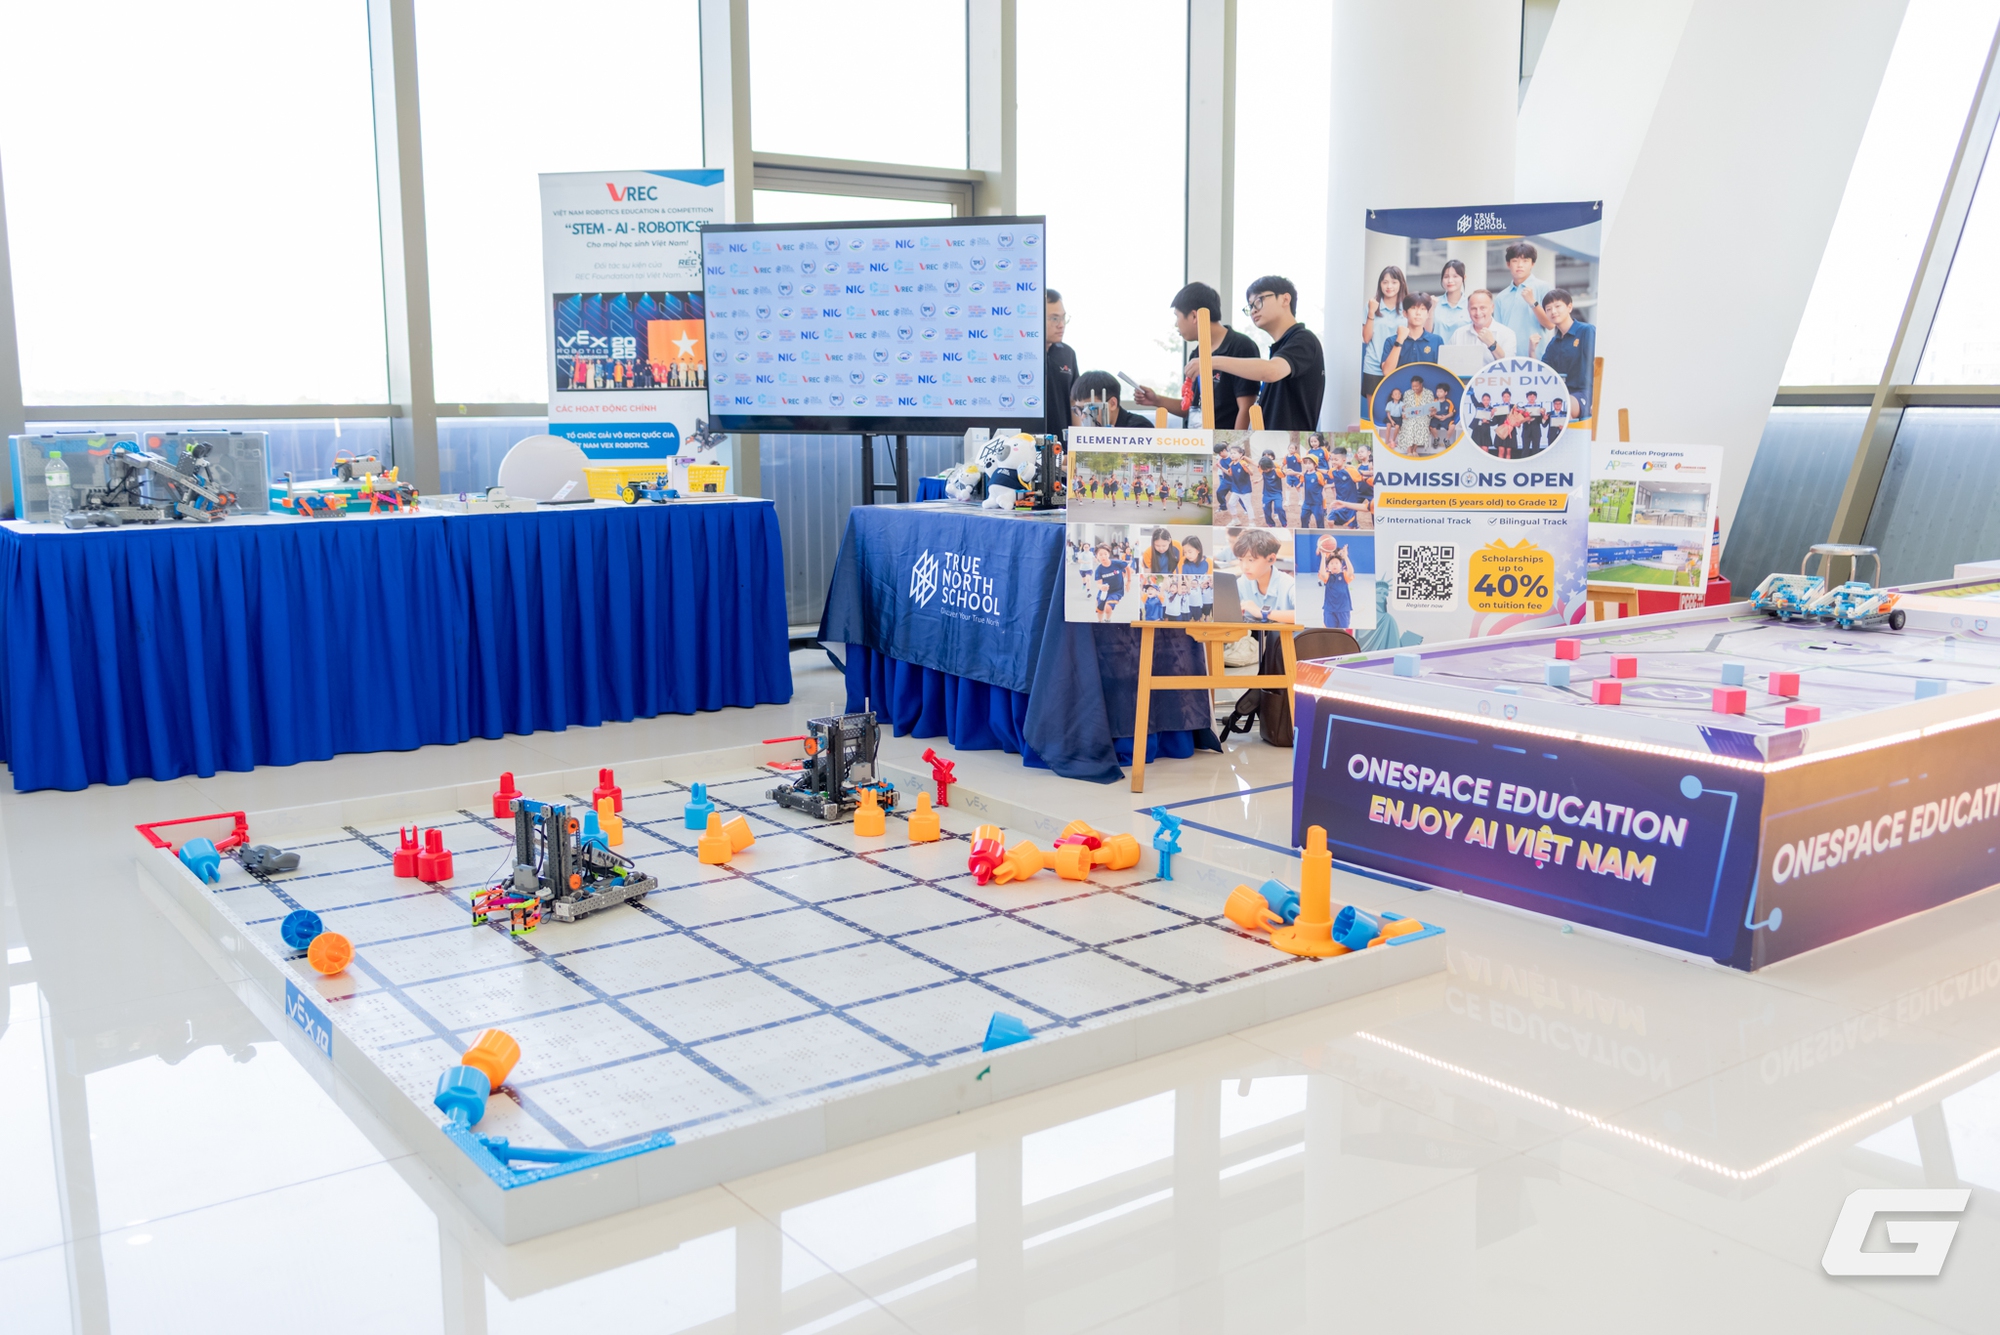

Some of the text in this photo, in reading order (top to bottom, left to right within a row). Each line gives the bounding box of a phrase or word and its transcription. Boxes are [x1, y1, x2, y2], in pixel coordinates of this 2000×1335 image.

[606, 183, 658, 202] VREC
[614, 222, 628, 234] AI
[603, 241, 617, 249] mọi
[619, 240, 632, 249] học
[652, 240, 666, 248] Việt
[729, 243, 748, 253] NIC
[896, 239, 914, 249] NIC
[707, 266, 725, 275] NIC
[870, 262, 889, 272] NIC
[592, 272, 634, 280] Foundation
[846, 285, 865, 294] NIC
[1016, 282, 1036, 291] NIC
[823, 309, 842, 318] NIC
[992, 306, 1011, 316] NIC
[557, 330, 636, 348] VEX 20
[801, 331, 819, 340] NIC
[968, 329, 988, 339] NIC
[778, 353, 796, 362] NIC
[943, 352, 962, 361] NIC
[756, 374, 774, 384] NIC
[918, 375, 937, 384] NIC
[735, 396, 753, 405] NIC
[898, 397, 918, 406] NIC
[556, 404, 573, 412] CÁC
[602, 404, 628, 413] ĐỘNG
[630, 404, 657, 412] CHÍNH
[1076, 436, 1205, 446] ELEMENTARY SCHOOL
[1648, 450, 1684, 458] Programs
[1605, 460, 1620, 470] AP
[1513, 472, 1574, 487] OPEN
[1386, 498, 1446, 507] Kindergarten
[1449, 498, 1457, 507] (5
[1486, 498, 1504, 507] old)
[1518, 498, 1546, 507] Grade
[1548, 499, 1558, 507] 12
[1387, 516, 1471, 525] International Track
[1500, 518, 1568, 526] Bilingual Track
[944, 552, 981, 574] TRUE
[1482, 554, 1544, 564] Scholarships
[942, 570, 993, 595] NORTH
[1474, 574, 1548, 598] 40%
[941, 587, 1000, 616] SCHOOL
[1493, 601, 1524, 609] tuition
[1527, 602, 1542, 610] fee
[959, 612, 971, 620] Your
[972, 614, 985, 624] True
[986, 618, 1000, 627] North
[903, 777, 924, 792] VEX
[965, 796, 988, 812] VEX
[1347, 754, 1689, 848] ONESPACE EDUCATION
[1368, 794, 1657, 886] ENJOY AI VIỆT NAM
[1772, 810, 1906, 884] ONESPACE
[287, 994, 329, 1053] VEX IQ
